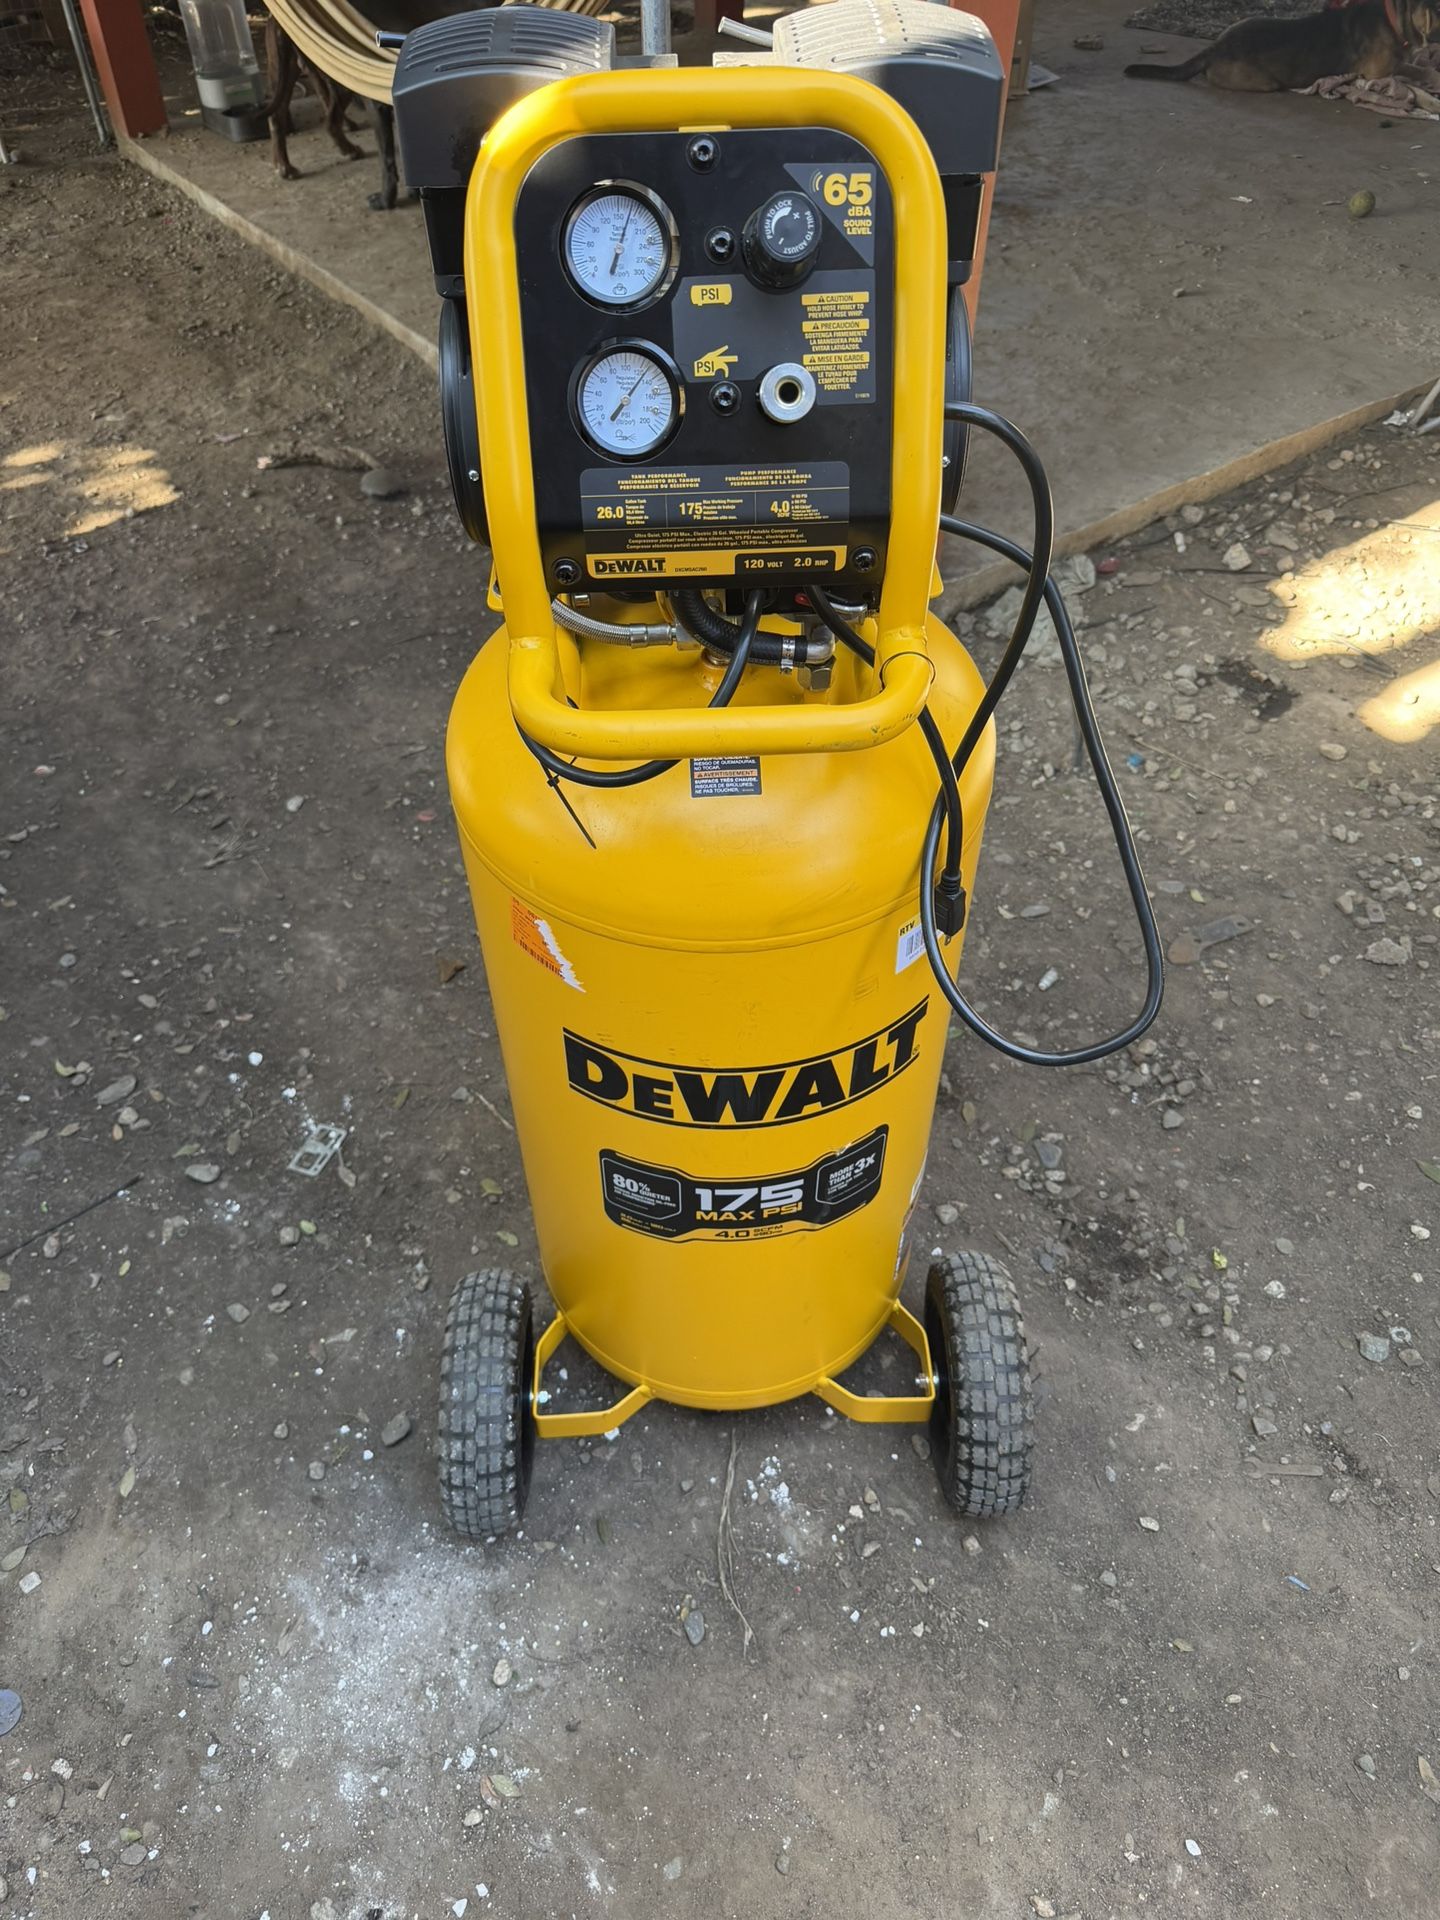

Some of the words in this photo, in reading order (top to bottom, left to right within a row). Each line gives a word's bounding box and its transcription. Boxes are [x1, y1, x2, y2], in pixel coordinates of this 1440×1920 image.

[823, 172, 872, 206] 65
[775, 200, 792, 210] LOCK
[848, 206, 872, 216] dBA
[767, 208, 776, 219] TO
[804, 210, 814, 229] PULL
[764, 218, 773, 240] PUSH
[844, 219, 872, 227] SOUND
[805, 231, 814, 240] TO
[783, 240, 808, 254] ADJUST
[701, 288, 719, 300] PSI
[821, 321, 860, 329] PRECAUCIÓN
[696, 361, 714, 373] PSI
[597, 506, 624, 519] 26.0
[679, 502, 702, 515] 175
[770, 500, 790, 513] 4.0
[594, 560, 666, 573] DEWALT
[744, 559, 764, 568] 120
[794, 558, 812, 567] 2.0
[900, 921, 915, 936] RTV
[564, 1002, 929, 1123] DEWALT
[854, 1152, 876, 1174] 3X
[829, 1164, 854, 1180] MORE
[613, 1173, 650, 1193] 80%
[828, 1172, 852, 1186] THAN
[639, 1190, 670, 1201] QUIETER
[695, 1179, 804, 1211] 175
[696, 1210, 755, 1221] MAX
[763, 1202, 802, 1218] PSI
[715, 1229, 750, 1238] 4.0
